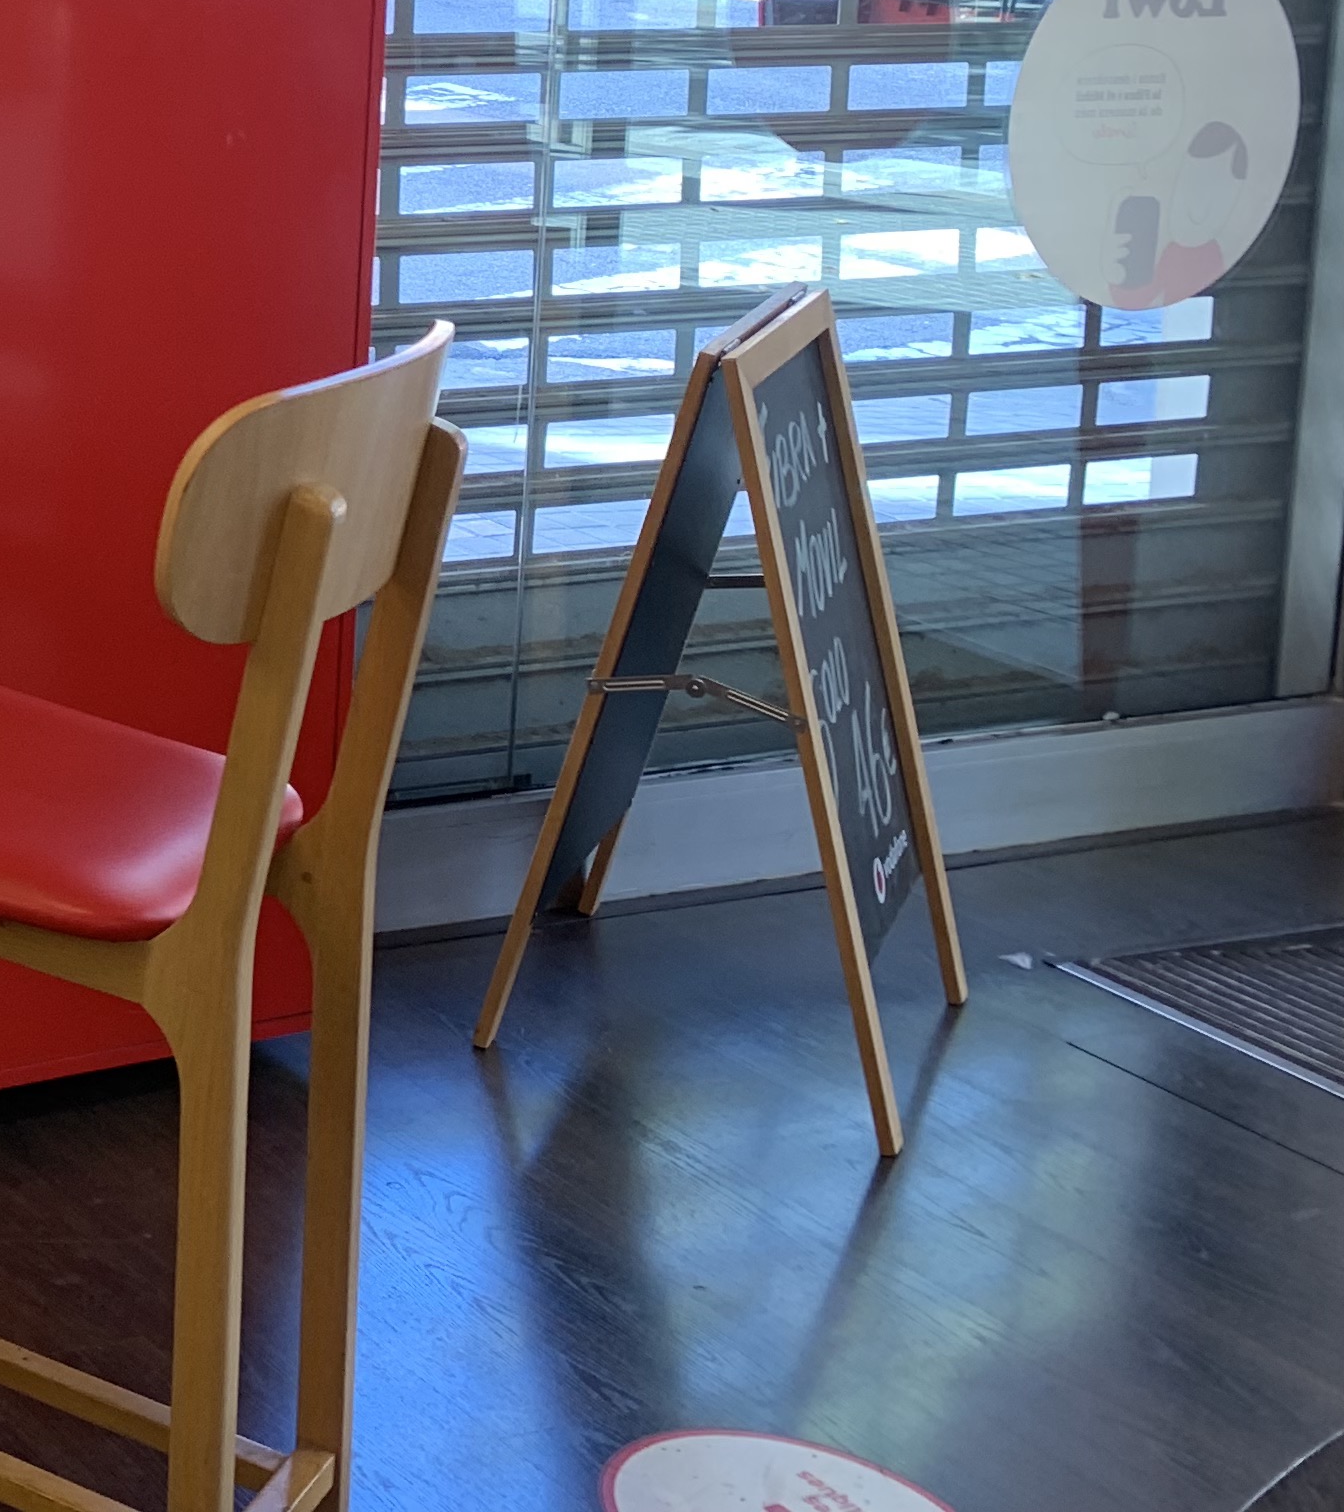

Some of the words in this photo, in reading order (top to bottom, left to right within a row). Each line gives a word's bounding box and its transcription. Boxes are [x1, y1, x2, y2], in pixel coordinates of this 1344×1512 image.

[759, 401, 817, 509] IBRA
[794, 507, 849, 619] MOVIL
[810, 636, 851, 724] OLO
